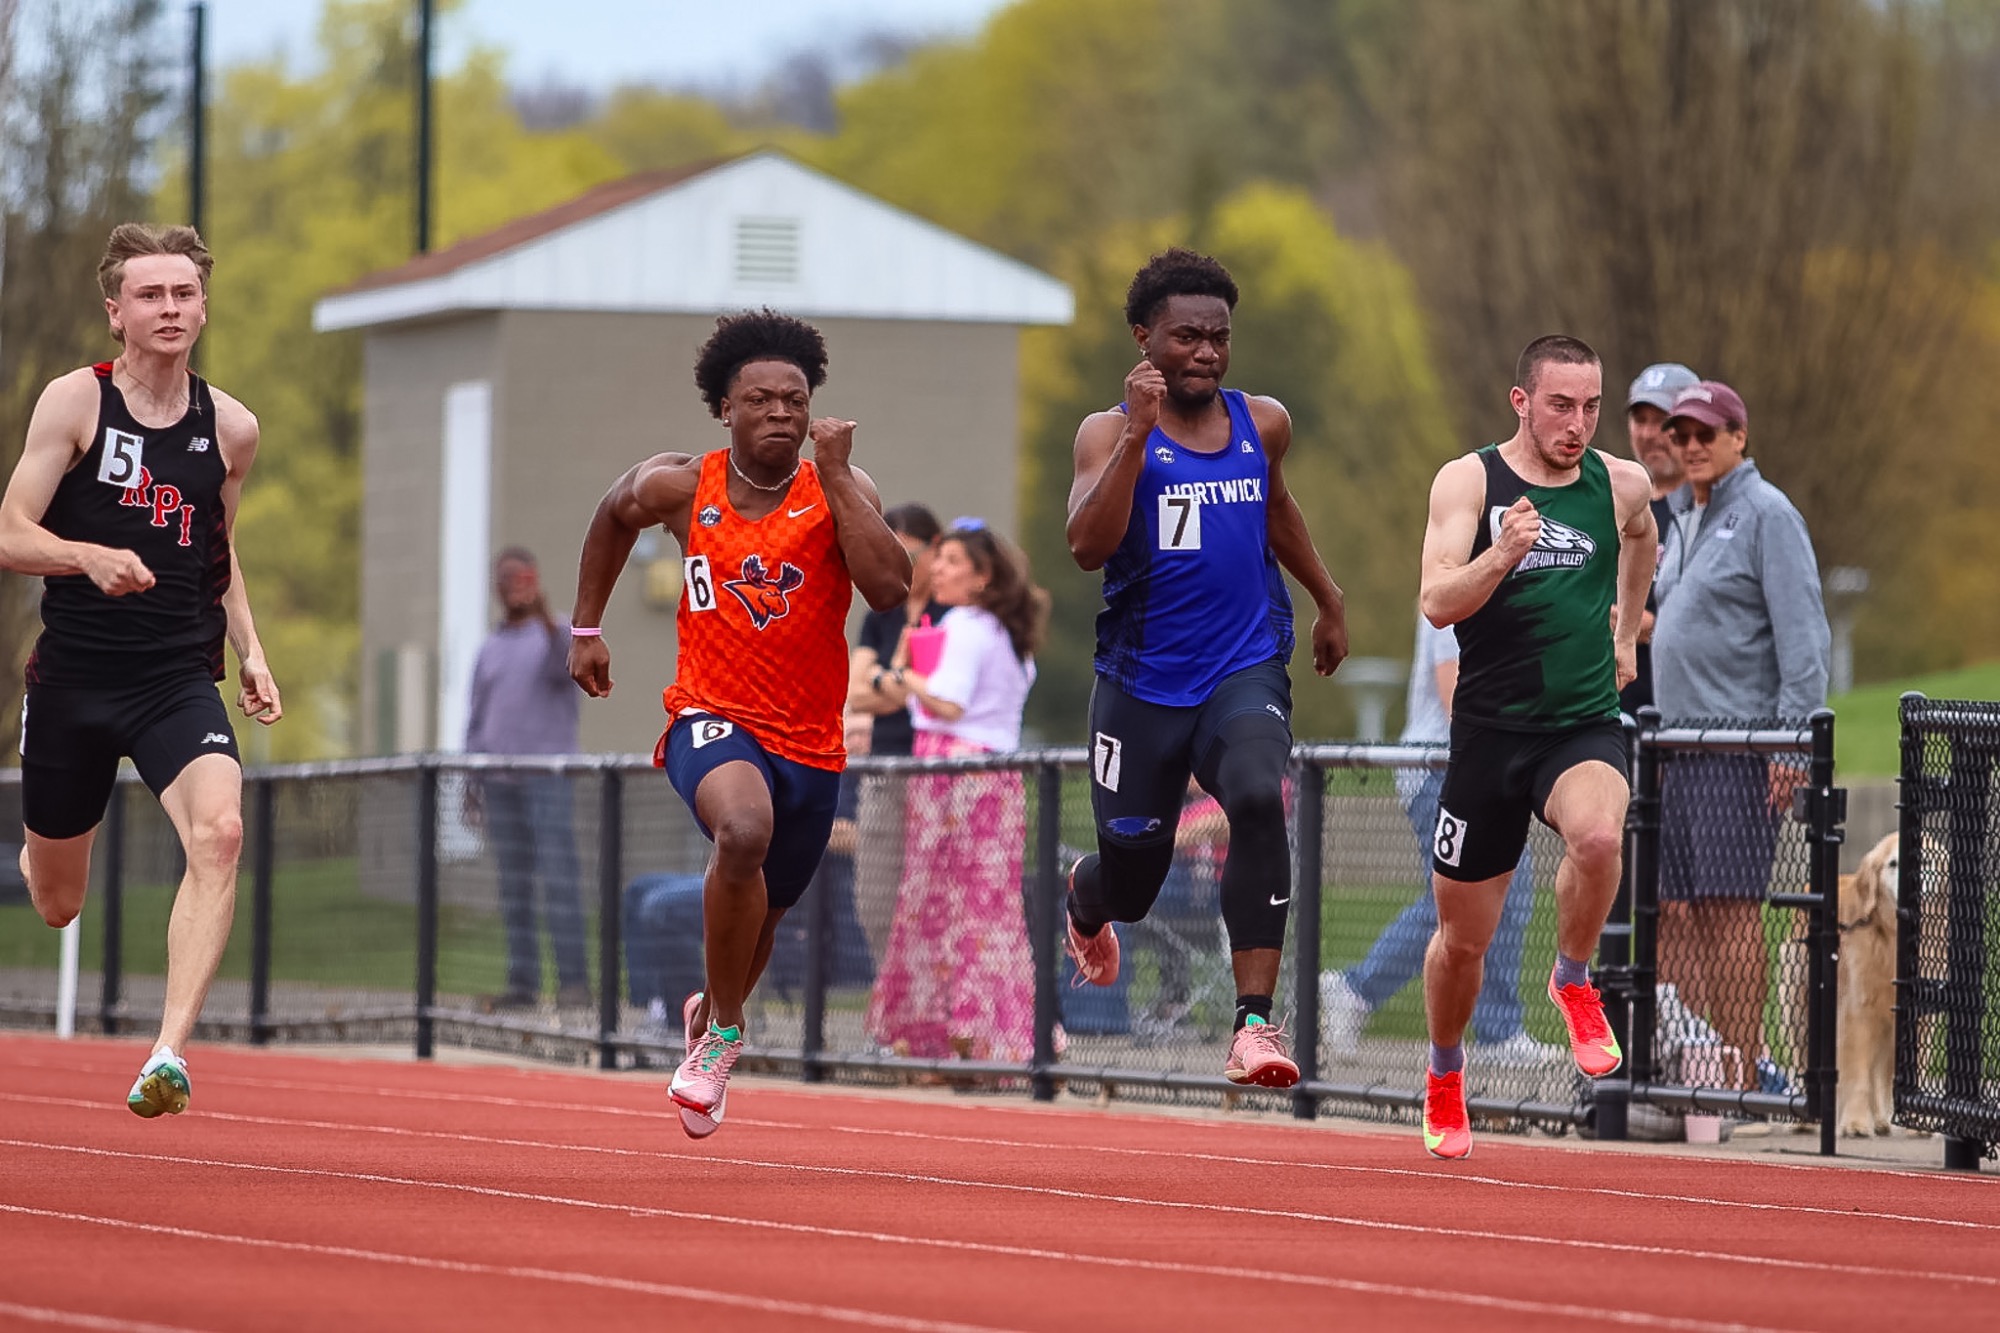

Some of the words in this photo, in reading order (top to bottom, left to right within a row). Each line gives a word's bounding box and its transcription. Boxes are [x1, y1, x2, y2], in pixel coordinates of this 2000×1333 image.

[108, 433, 136, 483] 5
[119, 465, 195, 546] RPI
[1167, 498, 1191, 547] 7
[690, 558, 710, 608] 6
[702, 721, 725, 741] 6
[1099, 736, 1114, 785] 7
[1438, 816, 1457, 860] 8
